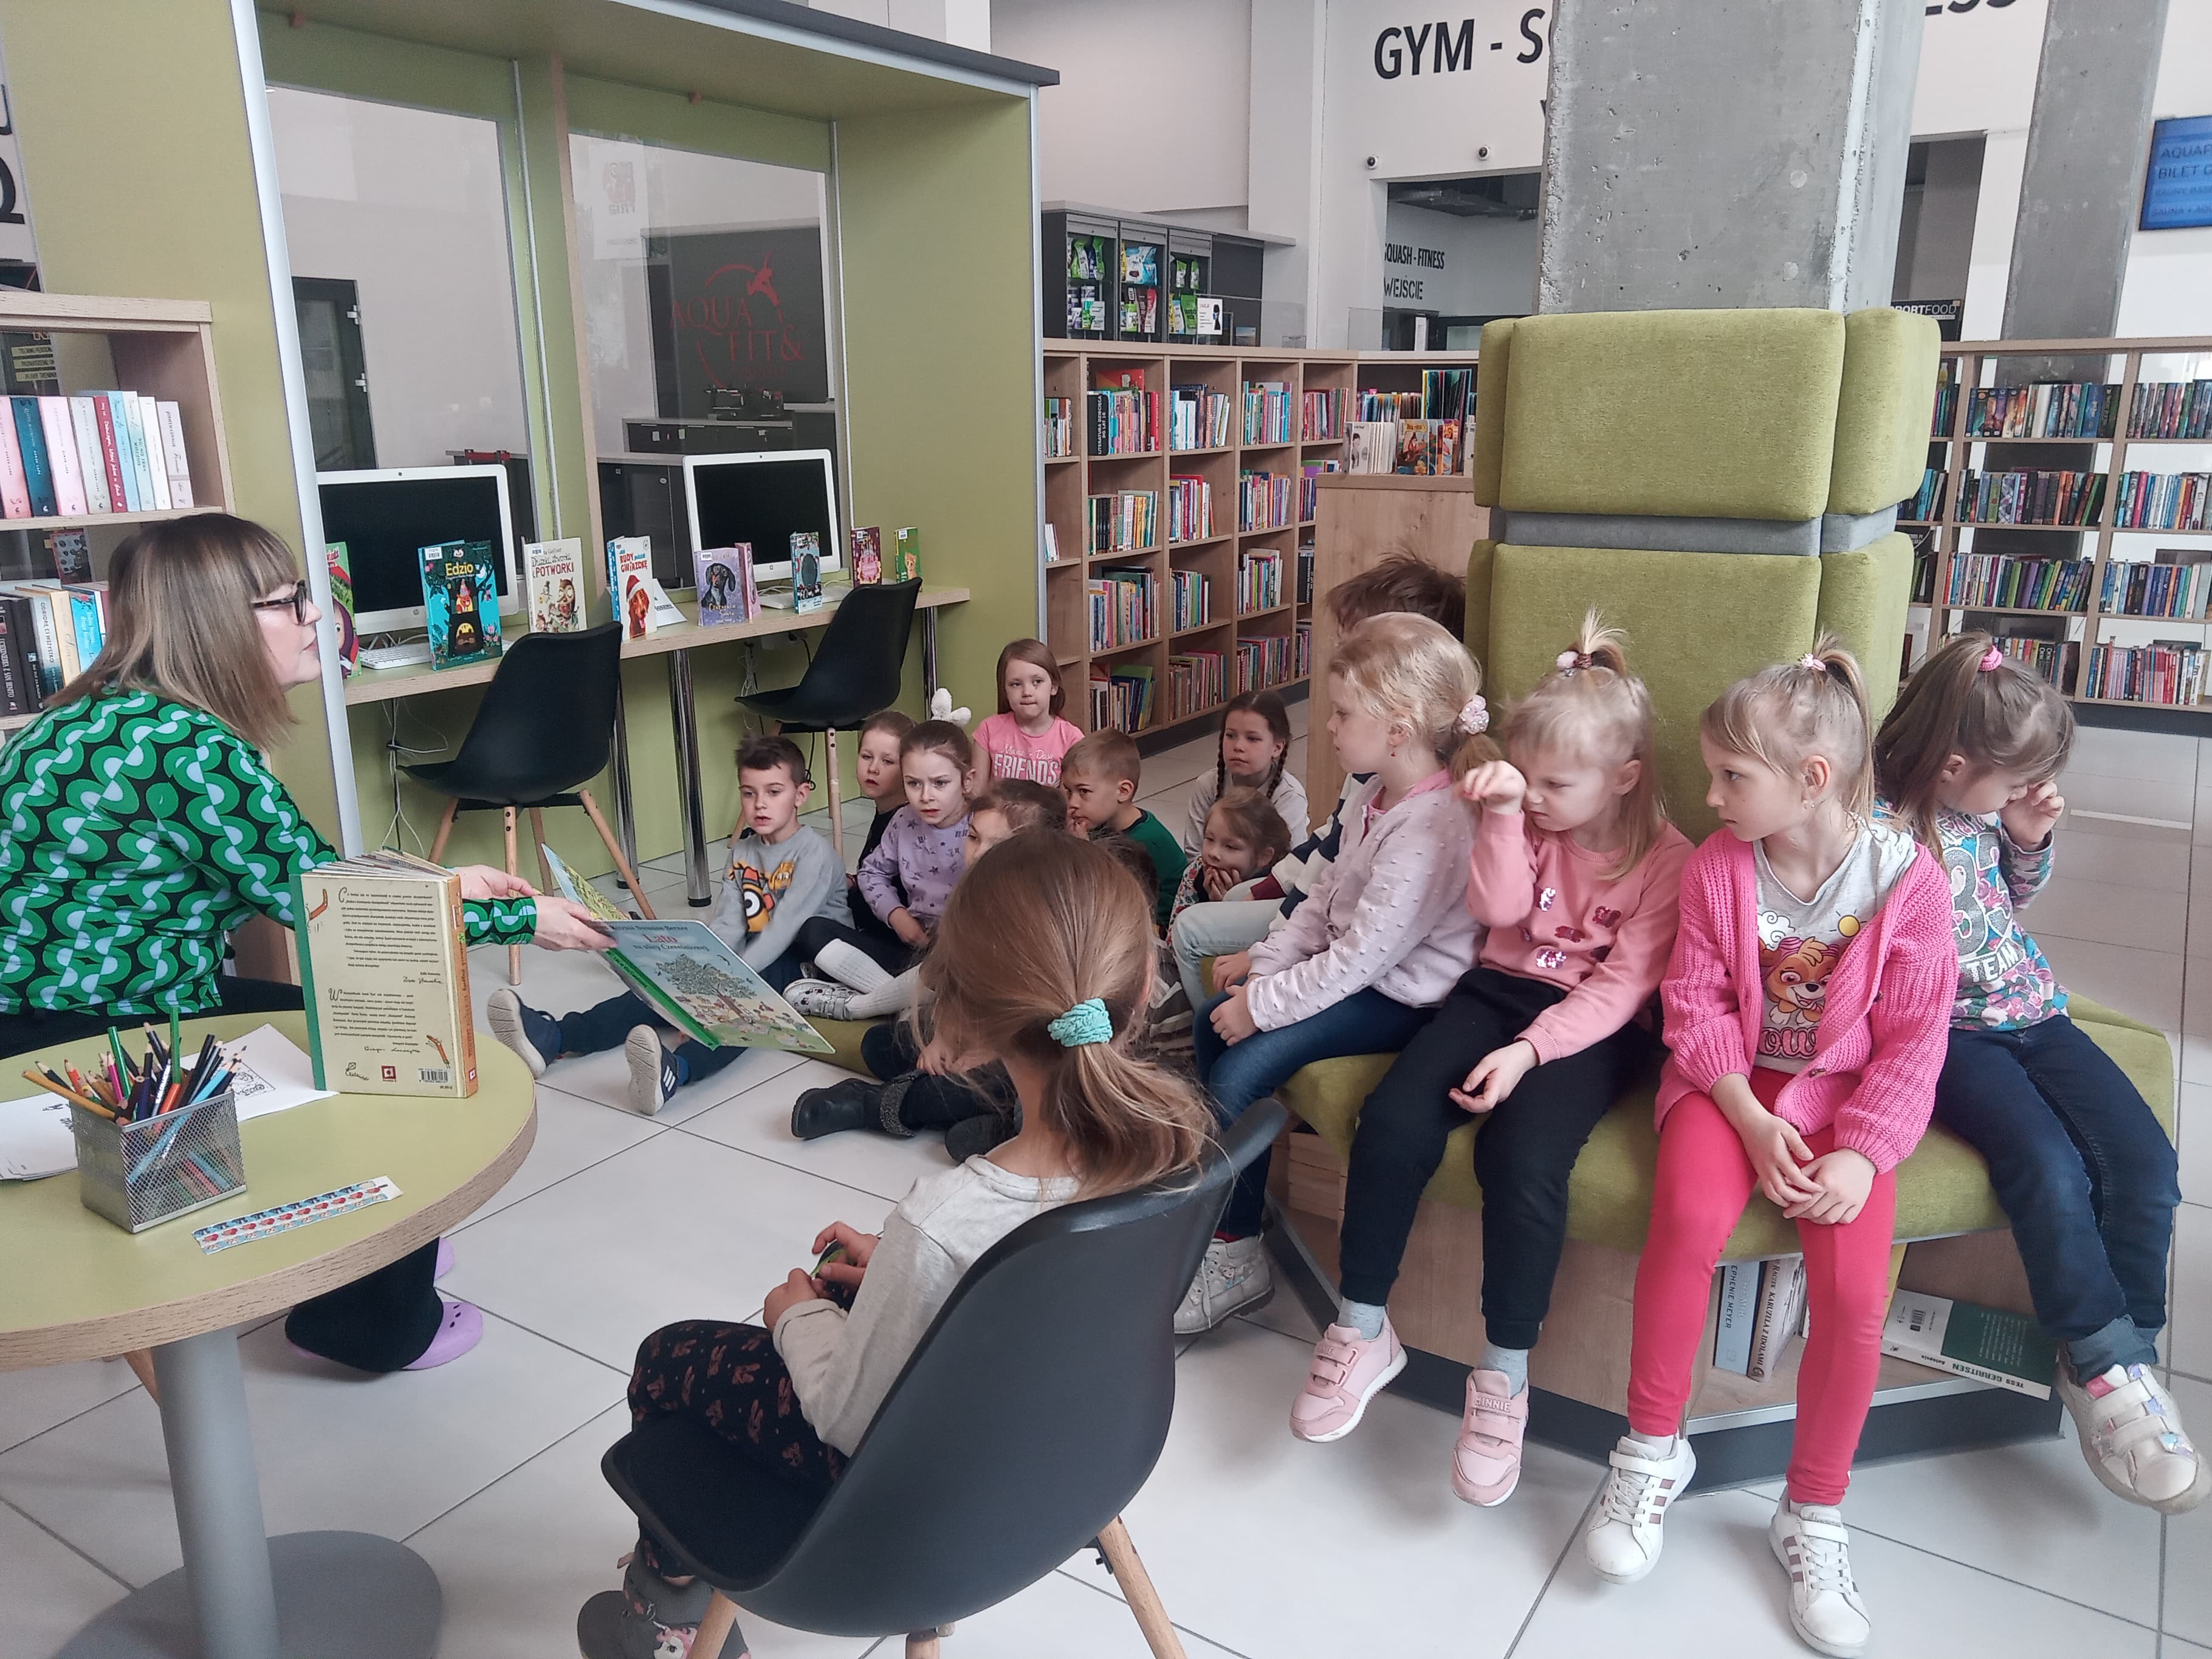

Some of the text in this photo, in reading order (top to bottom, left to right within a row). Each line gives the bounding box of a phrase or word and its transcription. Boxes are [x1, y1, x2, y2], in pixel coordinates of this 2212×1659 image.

[1375, 19, 1475, 80] GYM
[1517, 9, 1553, 63] S
[1417, 247, 1445, 270] FITNESS
[671, 297, 754, 335] AQUA
[729, 330, 777, 362] FIT
[445, 562, 474, 576] Edzio
[535, 562, 574, 578] POTWORKI
[620, 553, 634, 563] RUDY
[7, 682, 15, 698] BENITO
[994, 754, 1060, 786] FRIENDS
[642, 933, 678, 943] Lato
[1966, 942, 2019, 983] TEAM
[1770, 1265, 1781, 1289] RACZEK
[1725, 1265, 1737, 1329] EPHENIE MEYER
[1764, 1291, 1776, 1327] KARUZELA
[1757, 1335, 1768, 1365] IDOLAMI
[1952, 1363, 2024, 1389] TESS GERRITSEN
[1475, 1396, 1511, 1413] MINNIE
